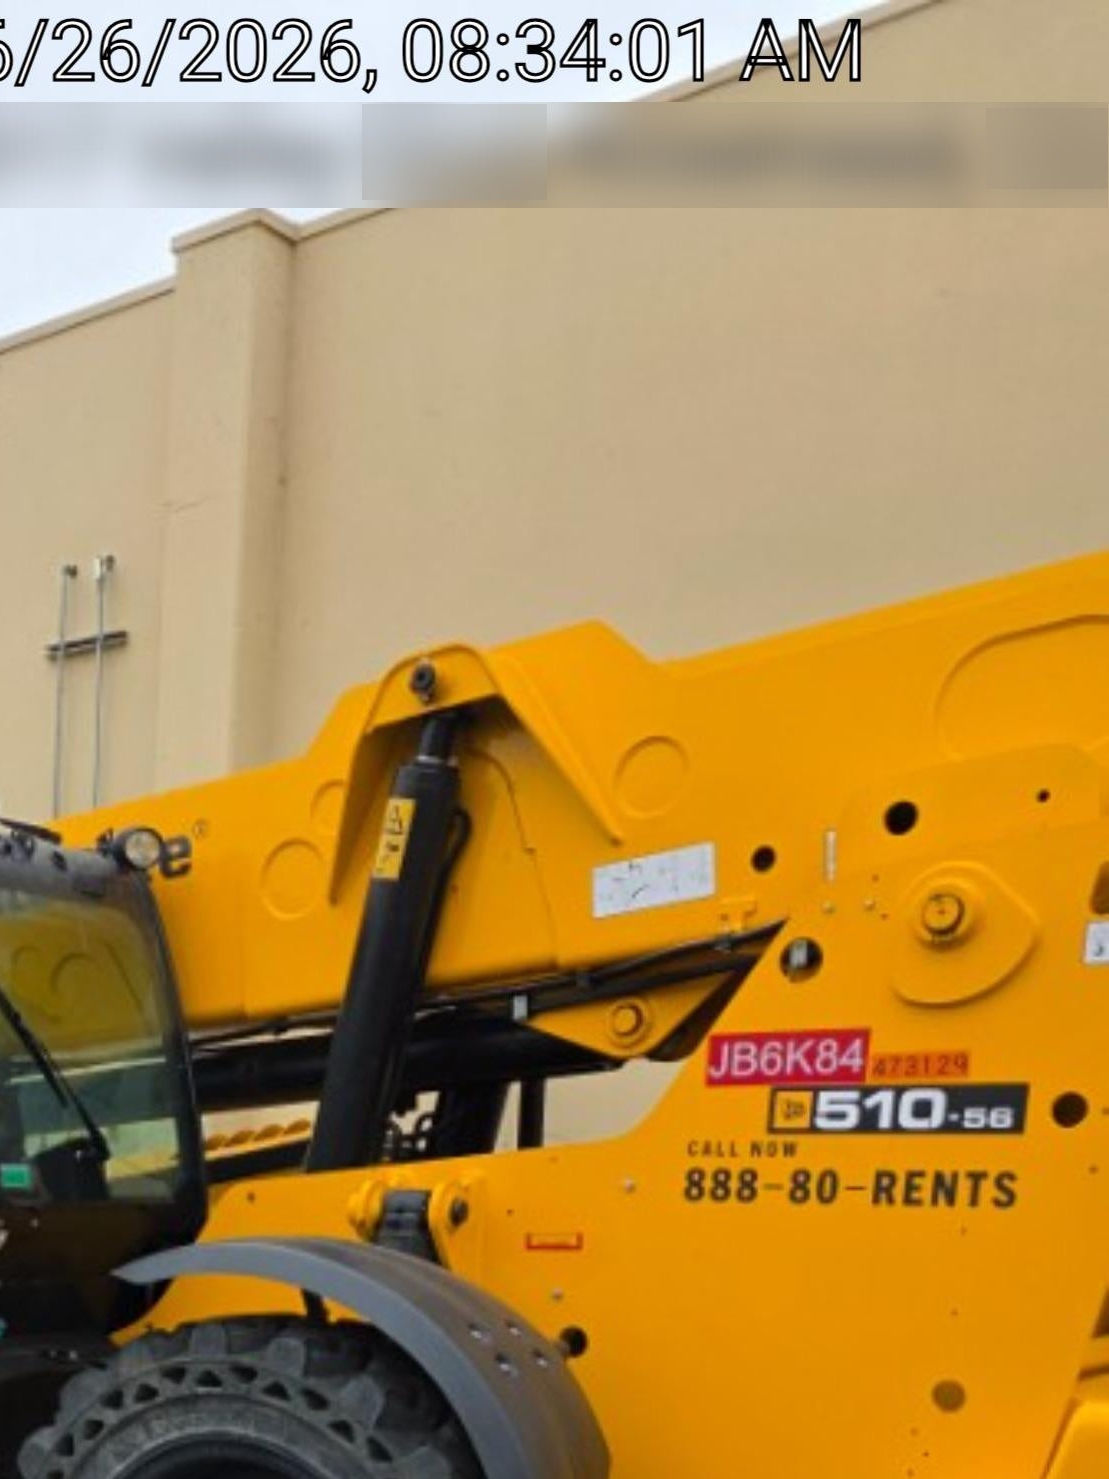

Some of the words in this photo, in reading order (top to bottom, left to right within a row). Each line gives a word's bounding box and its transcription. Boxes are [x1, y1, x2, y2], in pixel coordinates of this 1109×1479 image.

[709, 1038, 864, 1079] JB6K84
[686, 1140, 739, 1158] CALL
[750, 1140, 799, 1158] NOW
[684, 1166, 1018, 1208] 888-80-RENTS
